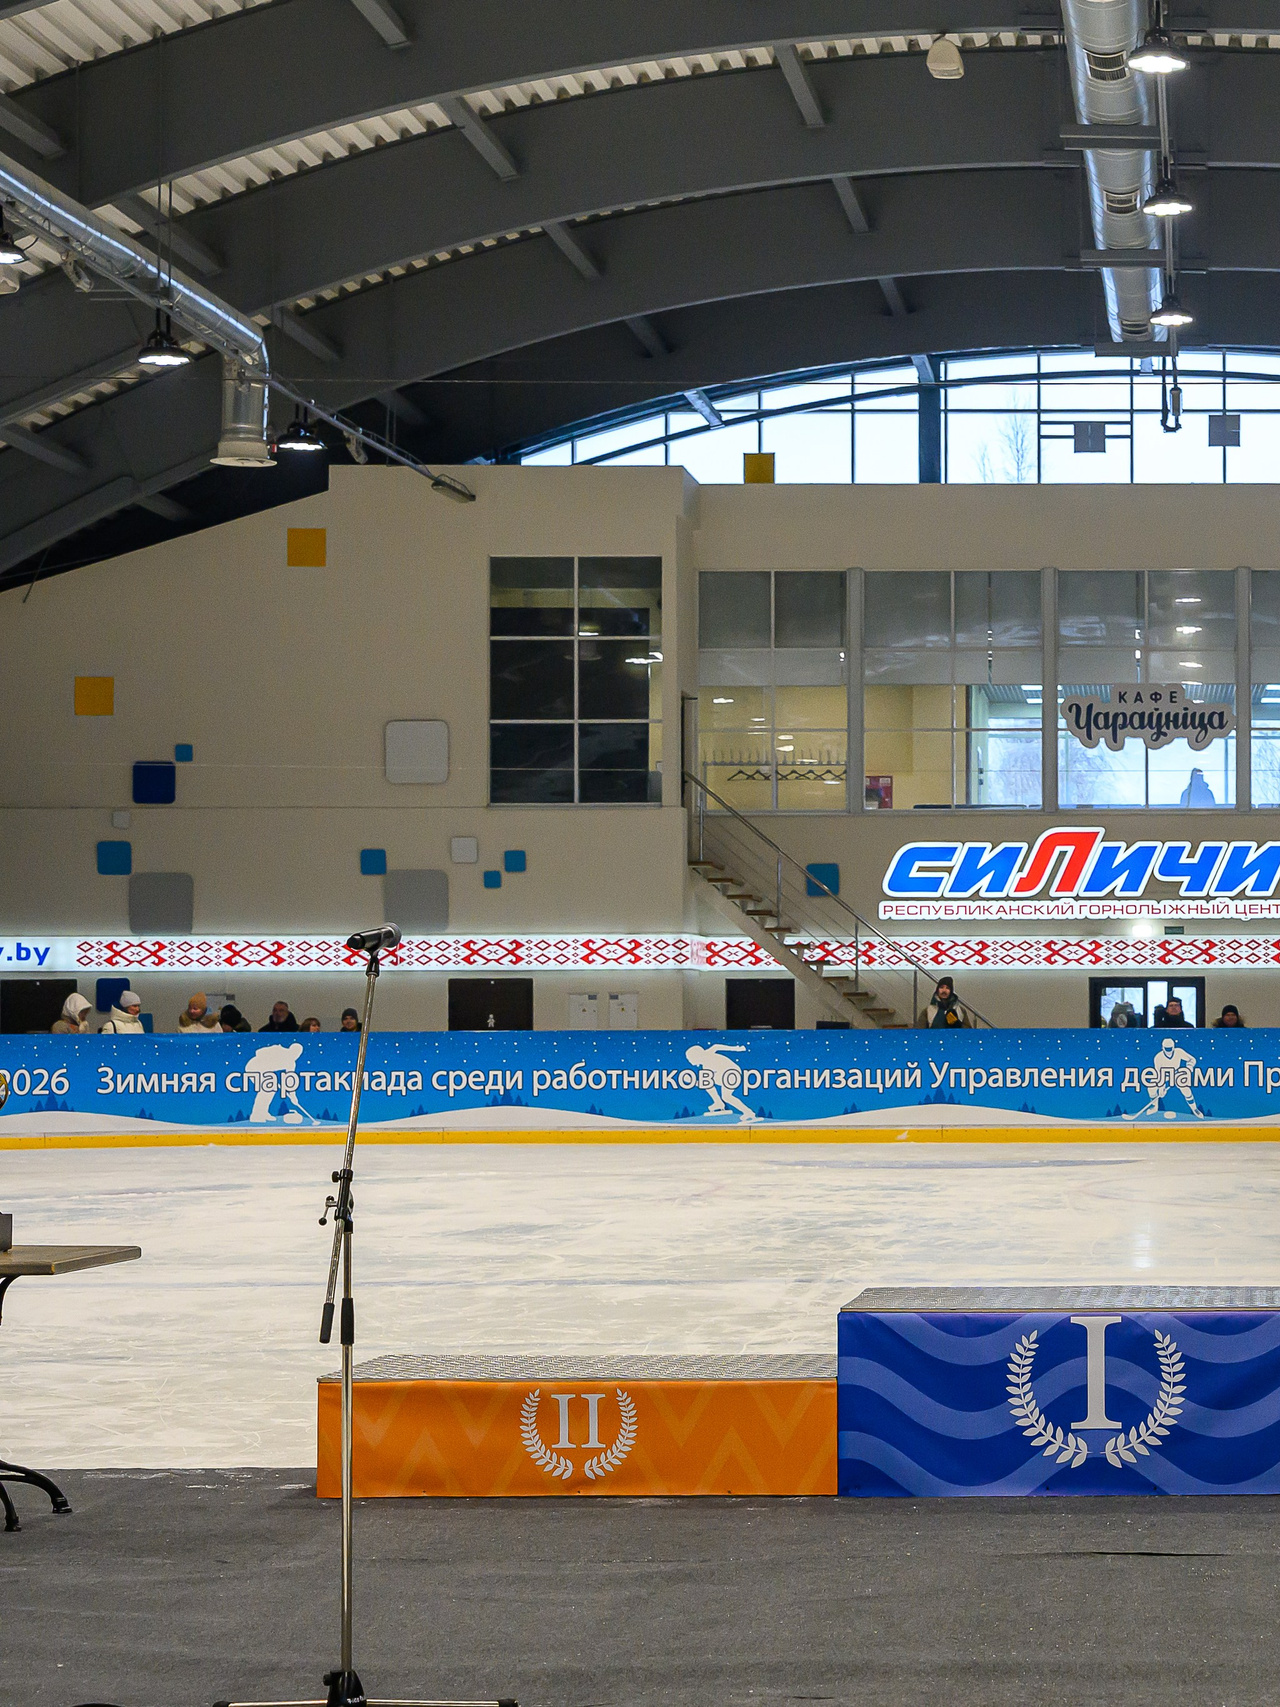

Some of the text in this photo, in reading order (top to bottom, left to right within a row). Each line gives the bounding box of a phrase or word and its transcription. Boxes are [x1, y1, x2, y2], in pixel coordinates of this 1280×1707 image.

[1118, 691, 1178, 704] КАФЕ
[1068, 703, 1229, 744] Чараўніца
[883, 902, 1074, 916] РЕСПУБЛИКАНСКИЙ
[1079, 901, 1230, 915] ГОРНОЛЫЖНЫЙ
[97, 1066, 215, 1094] Зимняя
[431, 1070, 524, 1097] среди
[532, 1061, 715, 1097] работников
[721, 1062, 922, 1097] организаций
[929, 1061, 1113, 1094] Управления
[1120, 1066, 1235, 1092] делами
[551, 1393, 606, 1449] II
